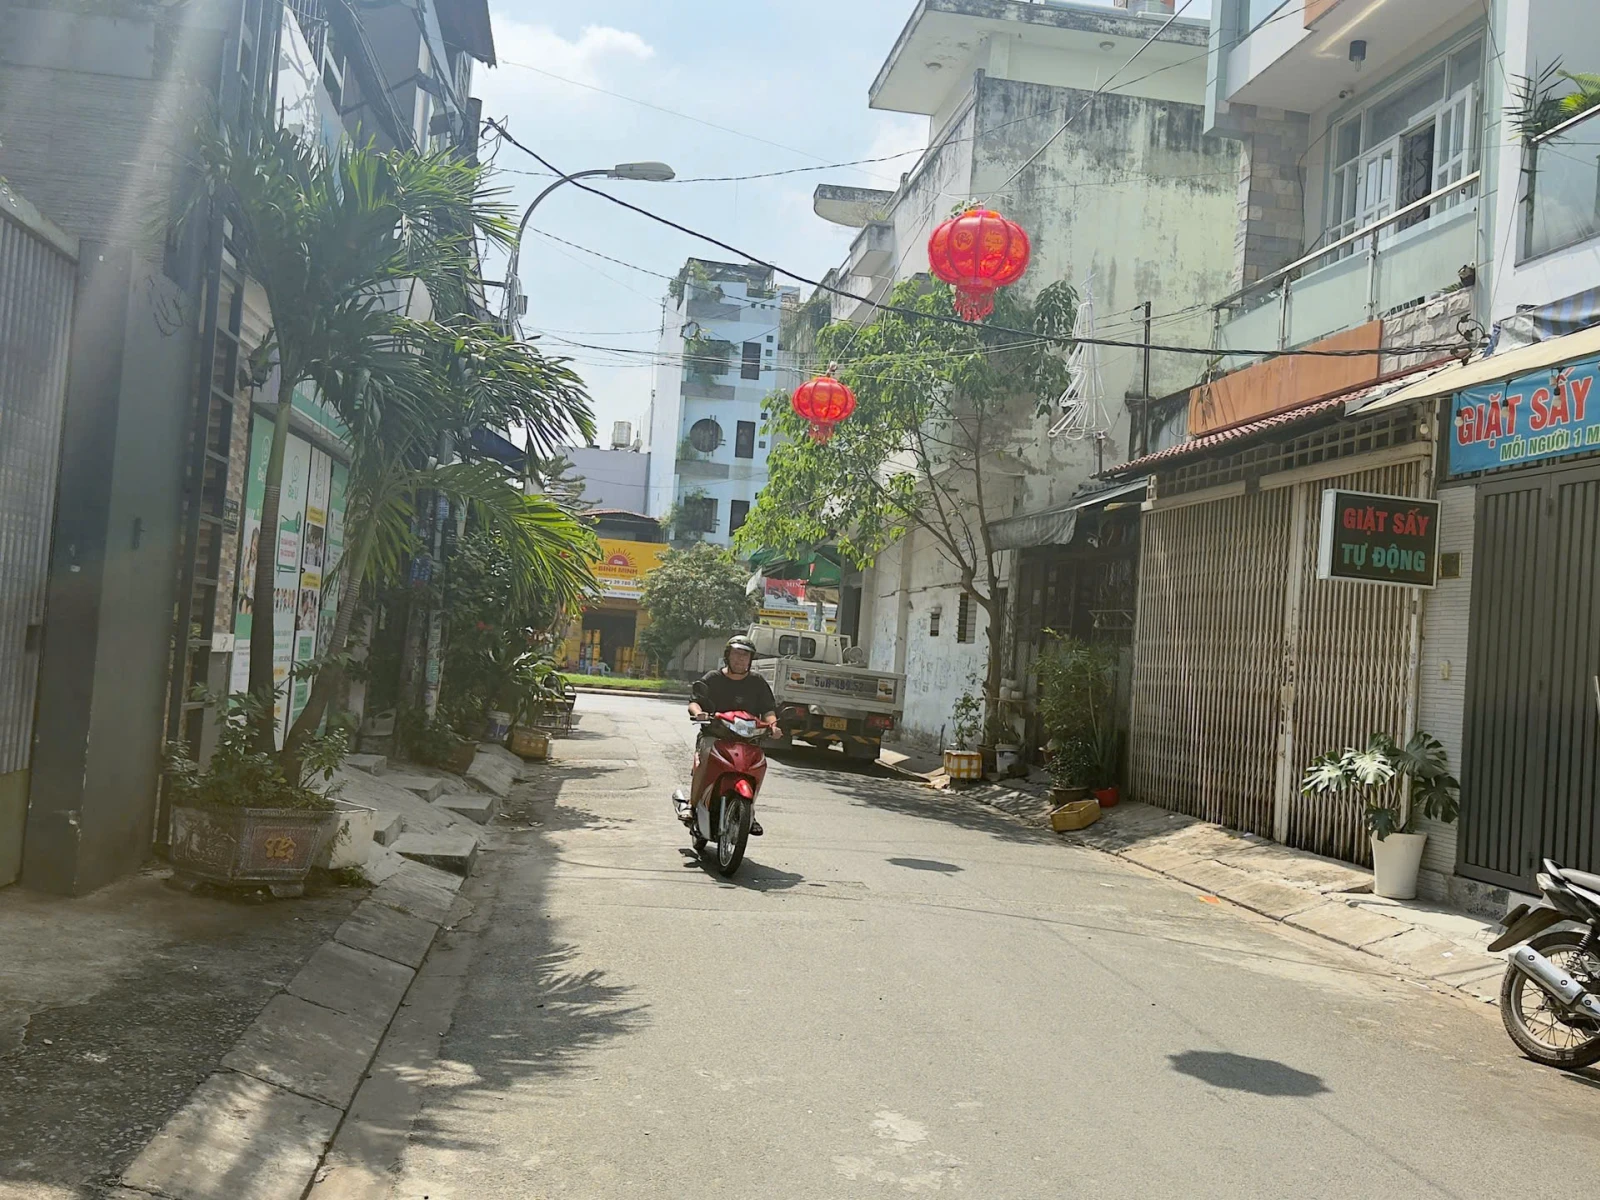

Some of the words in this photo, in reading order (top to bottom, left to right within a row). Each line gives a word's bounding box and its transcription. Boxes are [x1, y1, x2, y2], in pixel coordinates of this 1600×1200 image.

[1457, 392, 1522, 448] GIẶT
[1529, 367, 1593, 431] SẤY
[1500, 434, 1526, 461] MỖI
[1527, 428, 1570, 457] NGƯỜI
[1573, 428, 1582, 447] 1
[1343, 506, 1388, 535] GIẶT
[1392, 508, 1429, 537] SẤY
[1342, 542, 1368, 570] TỰ
[1372, 544, 1426, 574] ĐỘNG
